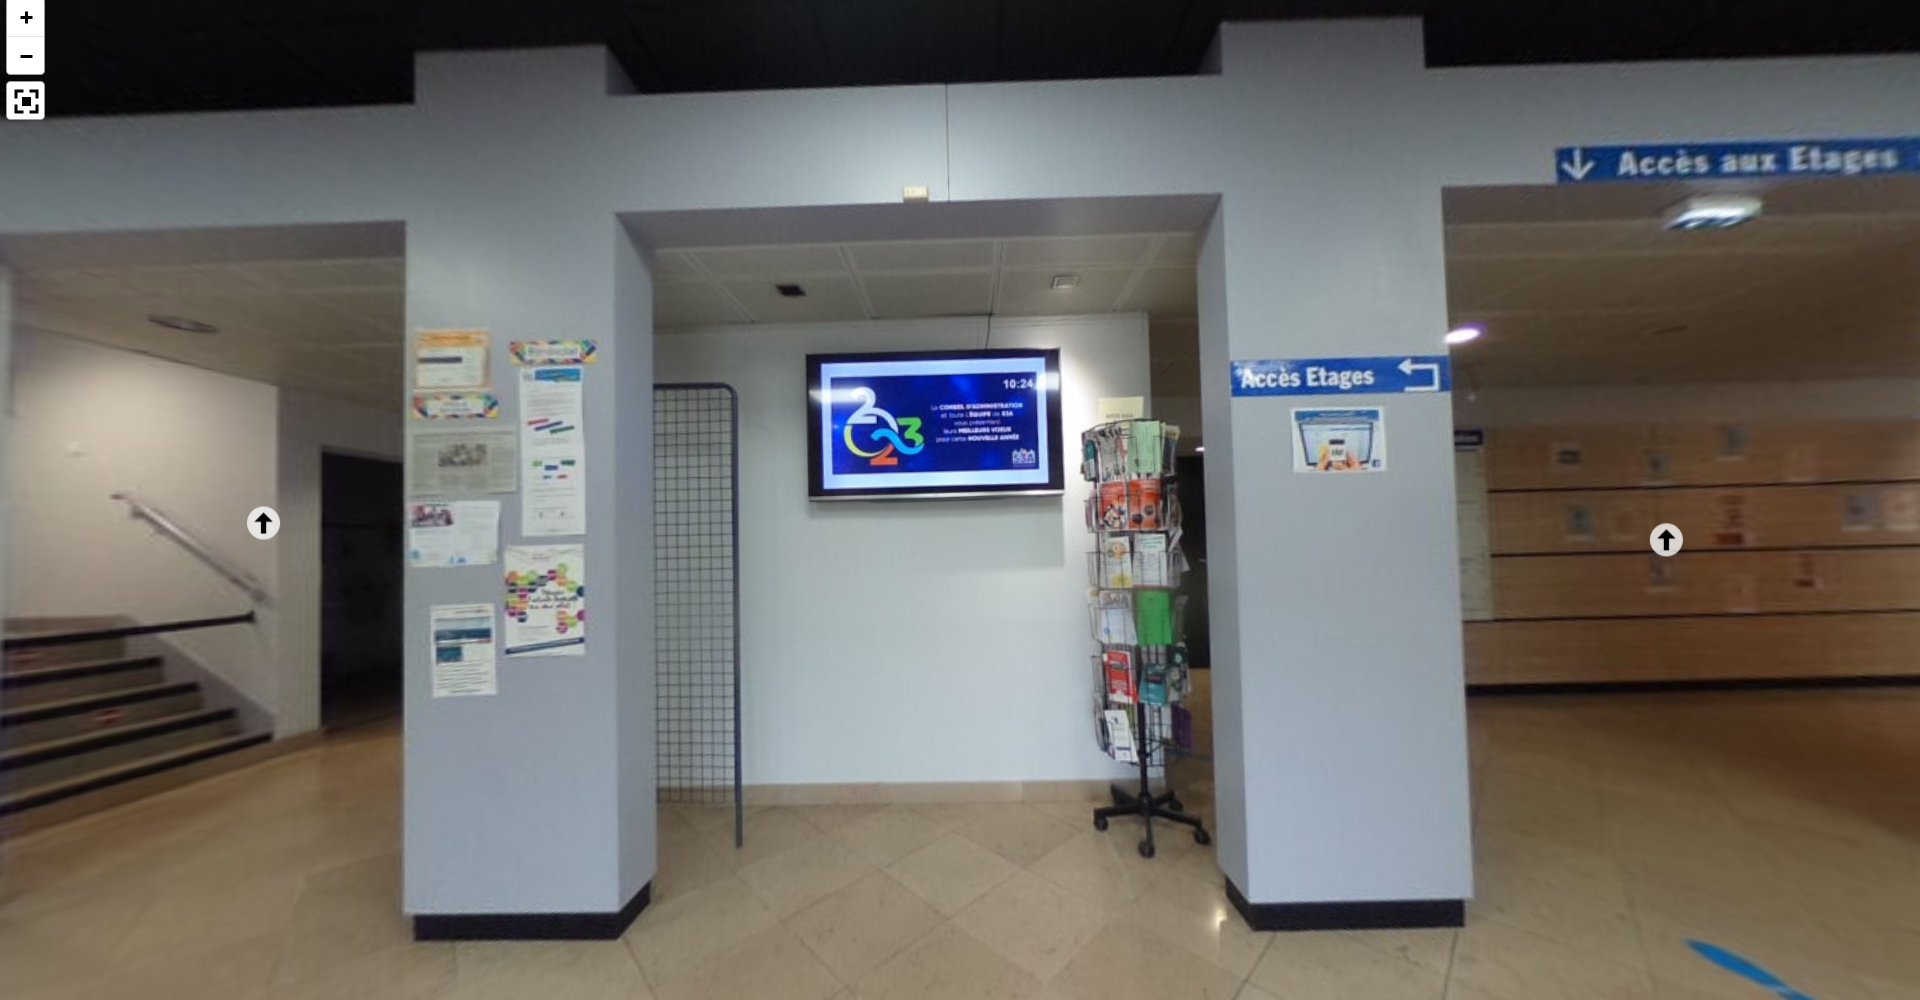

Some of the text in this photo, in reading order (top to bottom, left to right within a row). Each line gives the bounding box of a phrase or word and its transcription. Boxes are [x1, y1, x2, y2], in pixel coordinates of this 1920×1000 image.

[1617, 145, 1899, 176] Accès aux Etages
[1003, 379, 1034, 389] 10:24
[1241, 366, 1375, 390] Accès Etages
